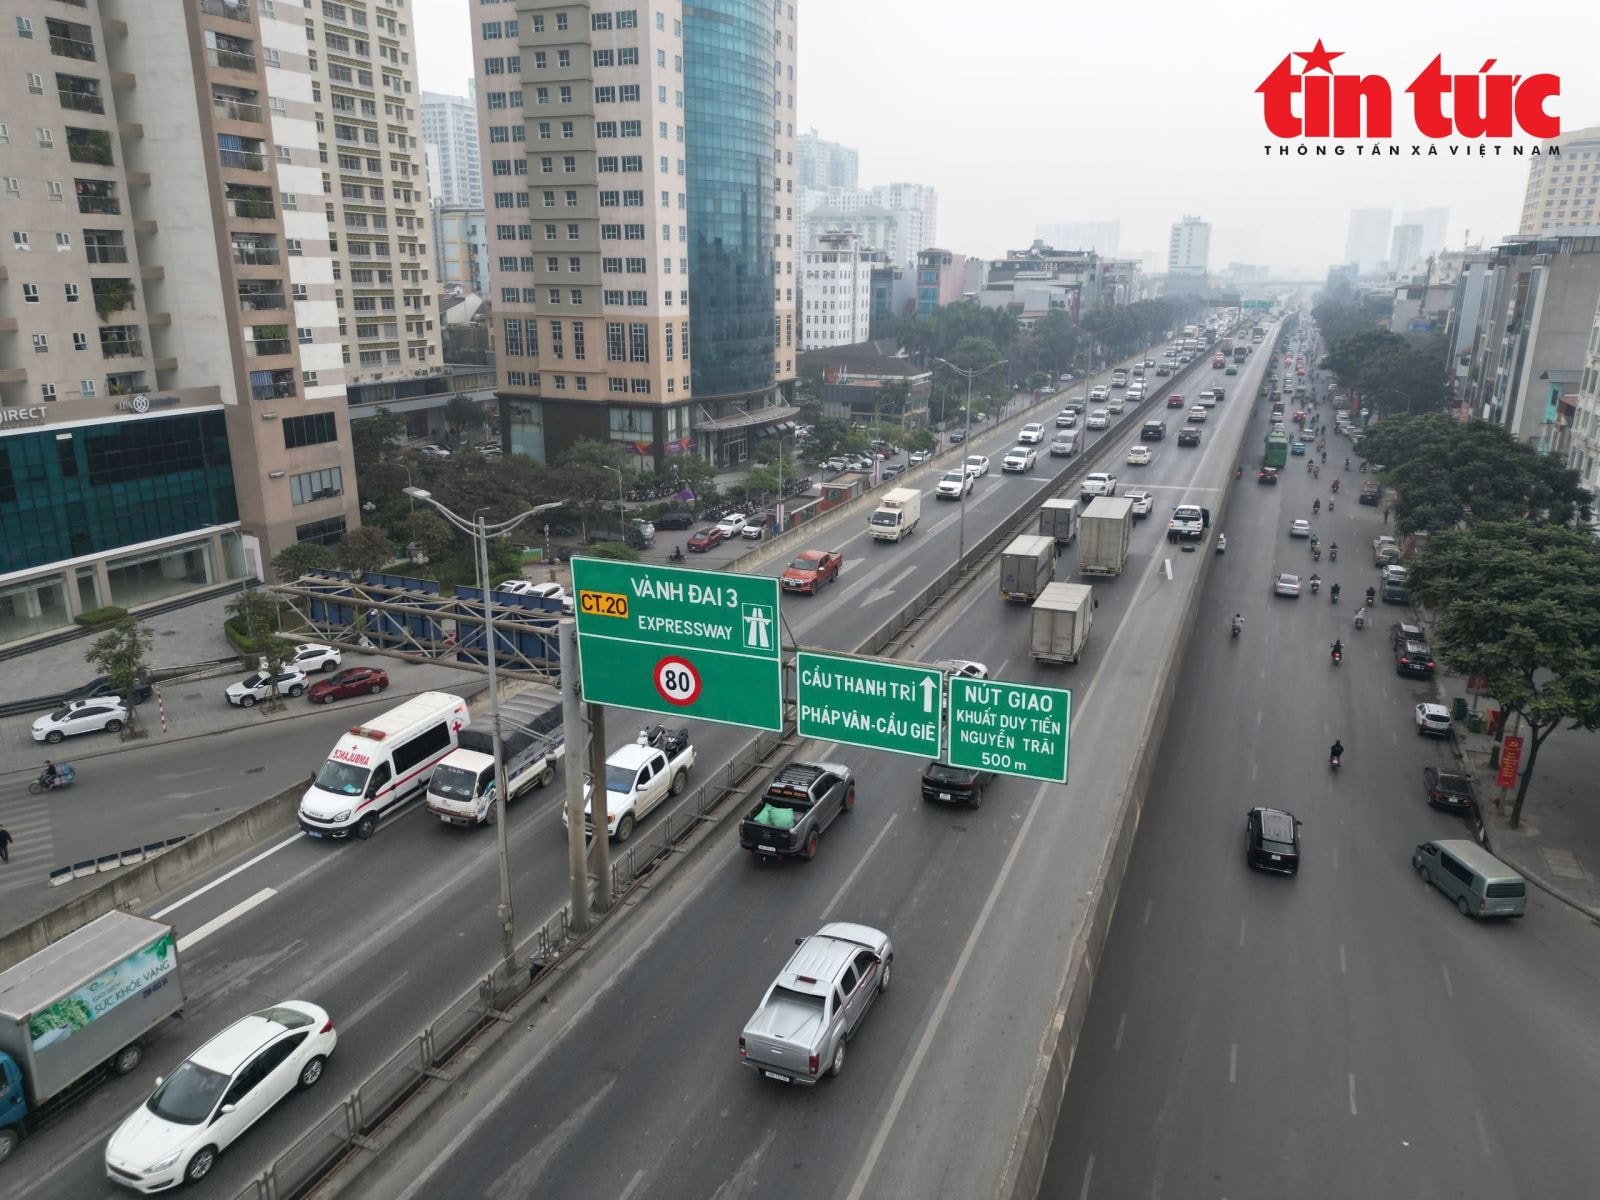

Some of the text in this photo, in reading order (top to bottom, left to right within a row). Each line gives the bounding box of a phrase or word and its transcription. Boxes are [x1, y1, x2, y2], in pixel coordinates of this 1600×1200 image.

[631, 575, 684, 602] VÀNH
[726, 589, 738, 607] 3
[581, 593, 627, 616] CT.20
[638, 615, 732, 640] EXPRESSWAY
[665, 670, 690, 692] 80
[802, 665, 916, 702] CẦU THANH TRÌ
[965, 683, 1053, 712] NÚT GIAO
[801, 705, 840, 725] PHÁP
[956, 707, 1061, 735] KHUẤT DUY TIẾN
[960, 729, 1054, 755] NGUYỄN TRÃI
[982, 752, 1027, 771] 500 m
